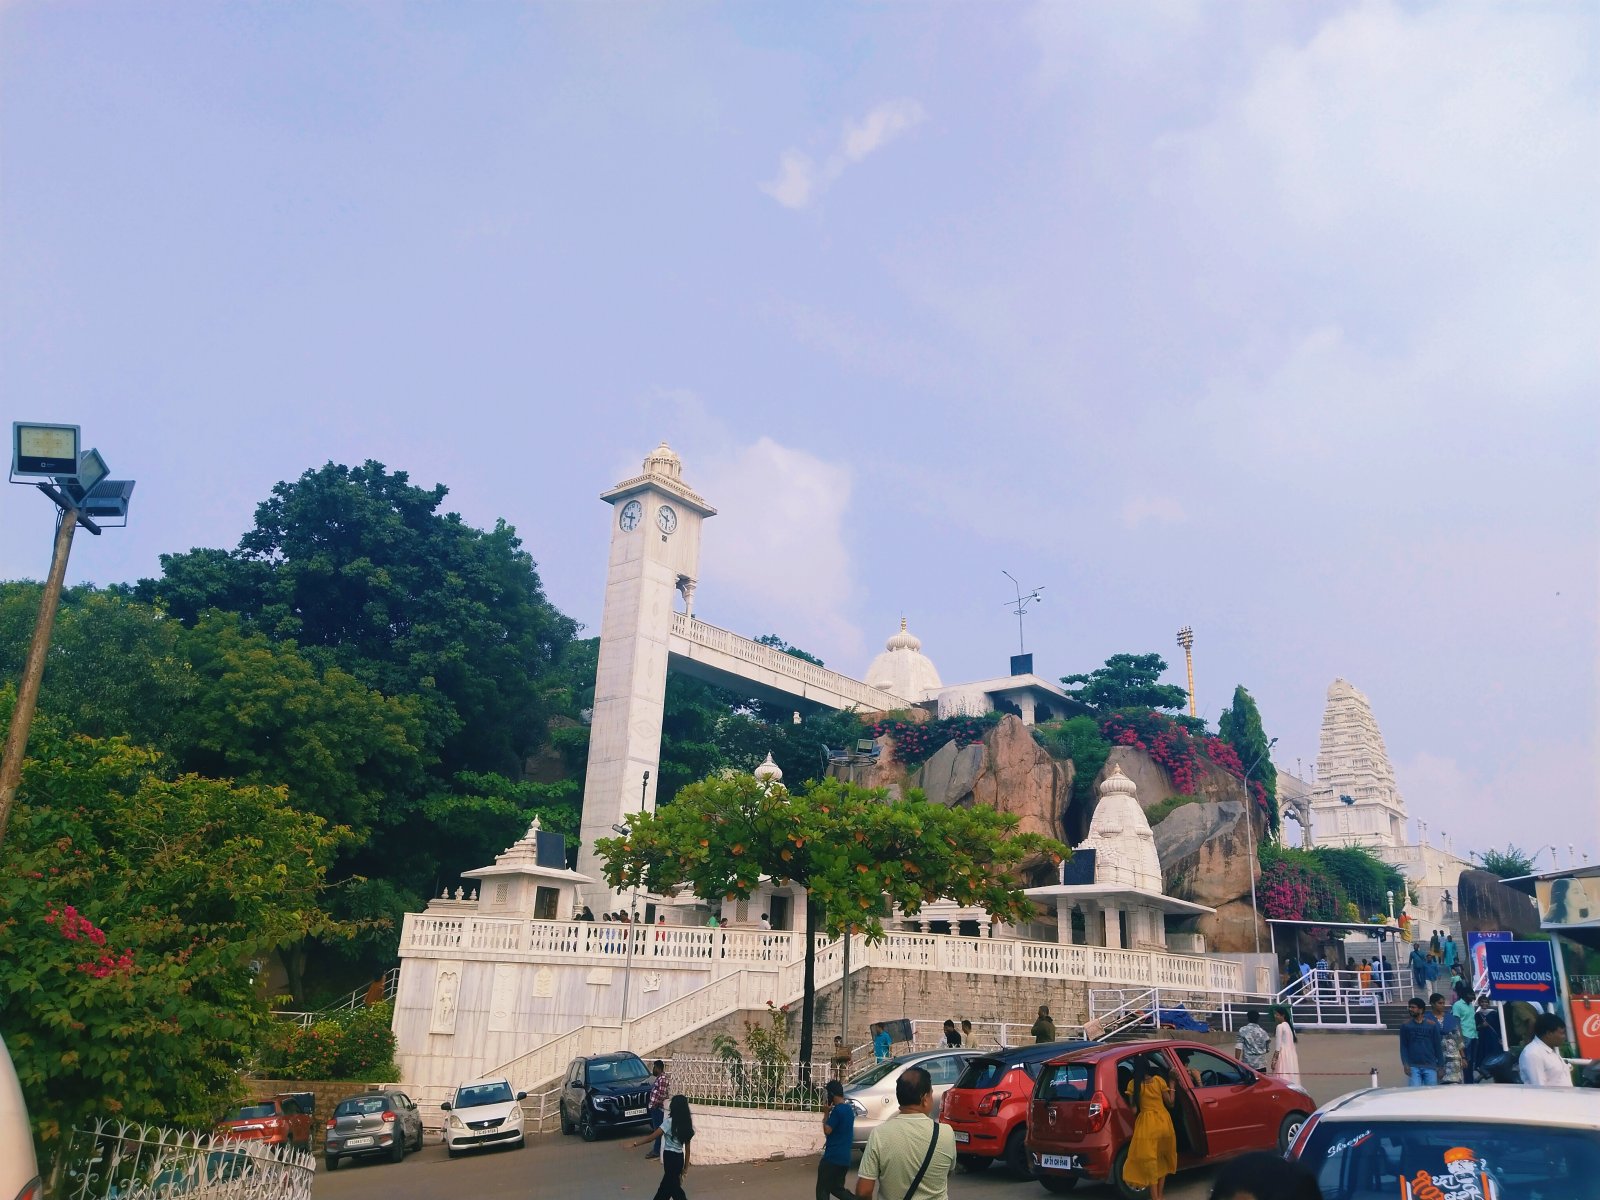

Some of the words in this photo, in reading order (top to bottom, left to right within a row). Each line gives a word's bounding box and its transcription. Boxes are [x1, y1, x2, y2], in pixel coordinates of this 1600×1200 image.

[1501, 954, 1521, 964] WAY
[1523, 954, 1536, 964] TO
[1491, 971, 1552, 981] WASHROOMS
[1327, 1129, 1371, 1158] Shreyas
